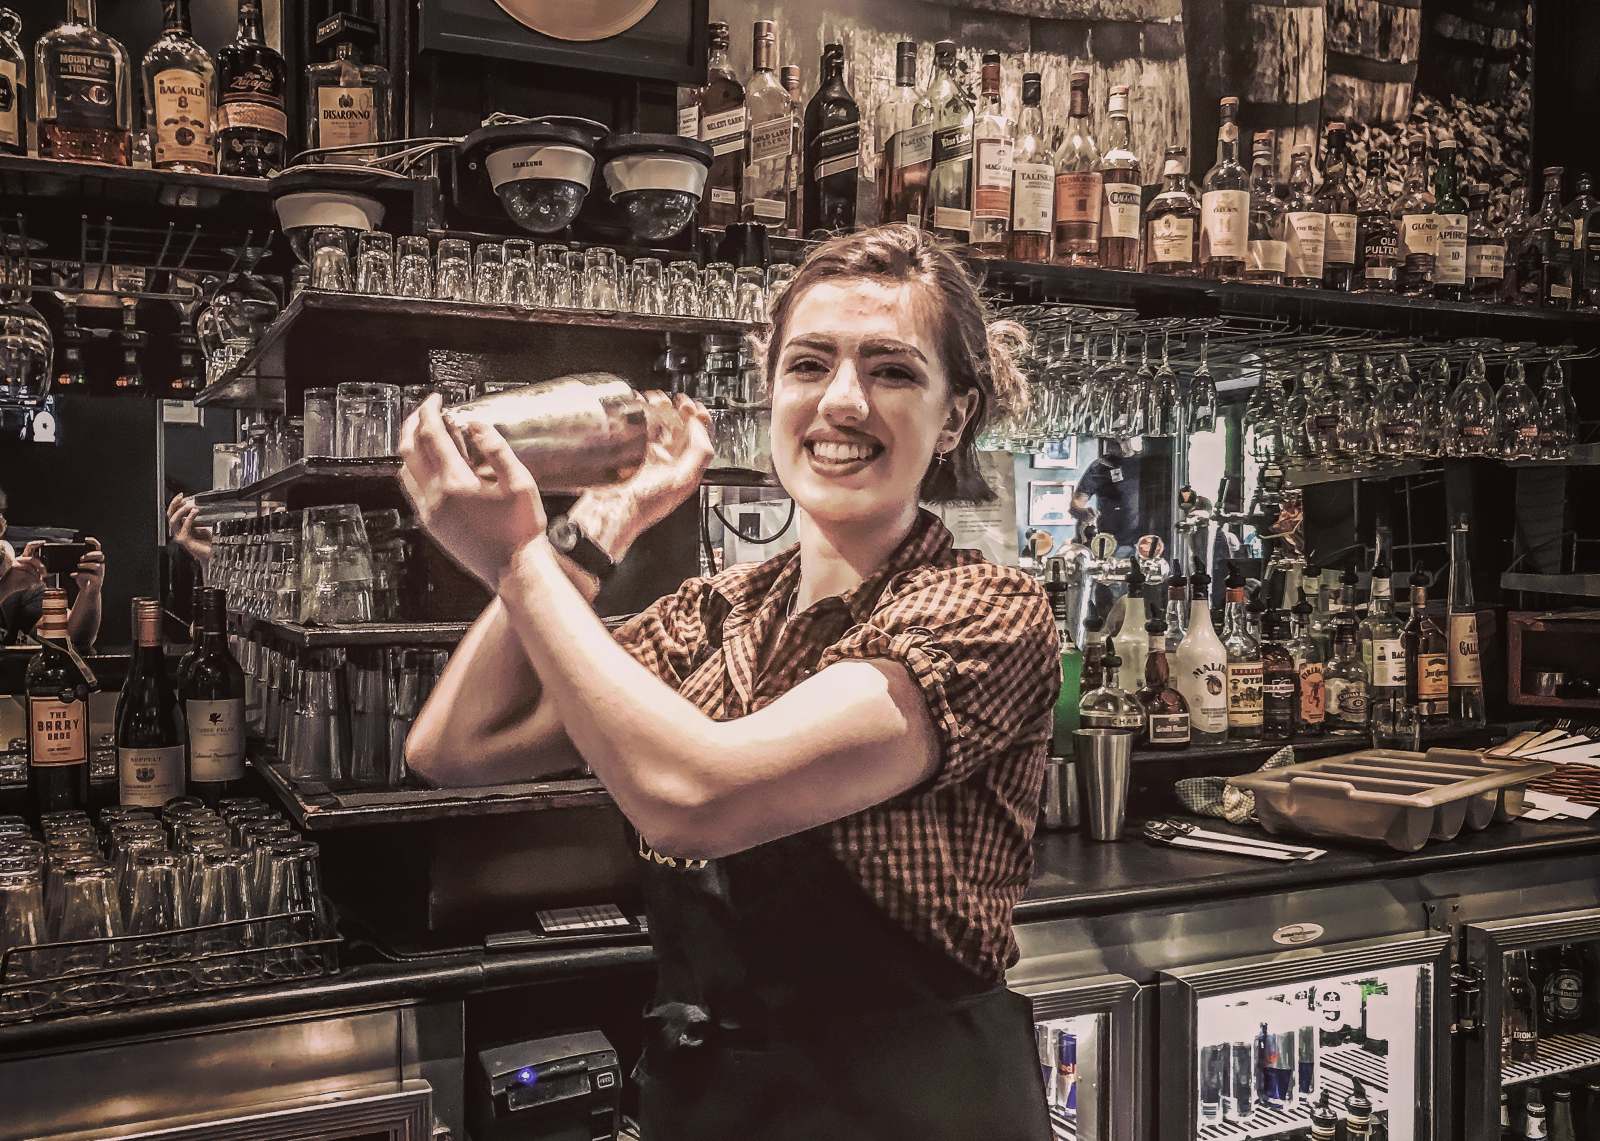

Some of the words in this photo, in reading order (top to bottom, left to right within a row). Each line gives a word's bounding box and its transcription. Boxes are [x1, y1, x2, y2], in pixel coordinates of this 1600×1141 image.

[60, 54, 92, 65] MOUNT
[93, 57, 110, 69] GAY
[177, 95, 189, 108] 8
[323, 109, 370, 120] DISARONNO
[512, 160, 543, 168] SAMSUNG
[1380, 237, 1397, 246] OLD
[1452, 251, 1460, 260] 10
[1460, 640, 1480, 656] GALL
[1392, 651, 1406, 659] BAC
[1192, 662, 1227, 679] MALIB
[37, 719, 79, 732] BARRY
